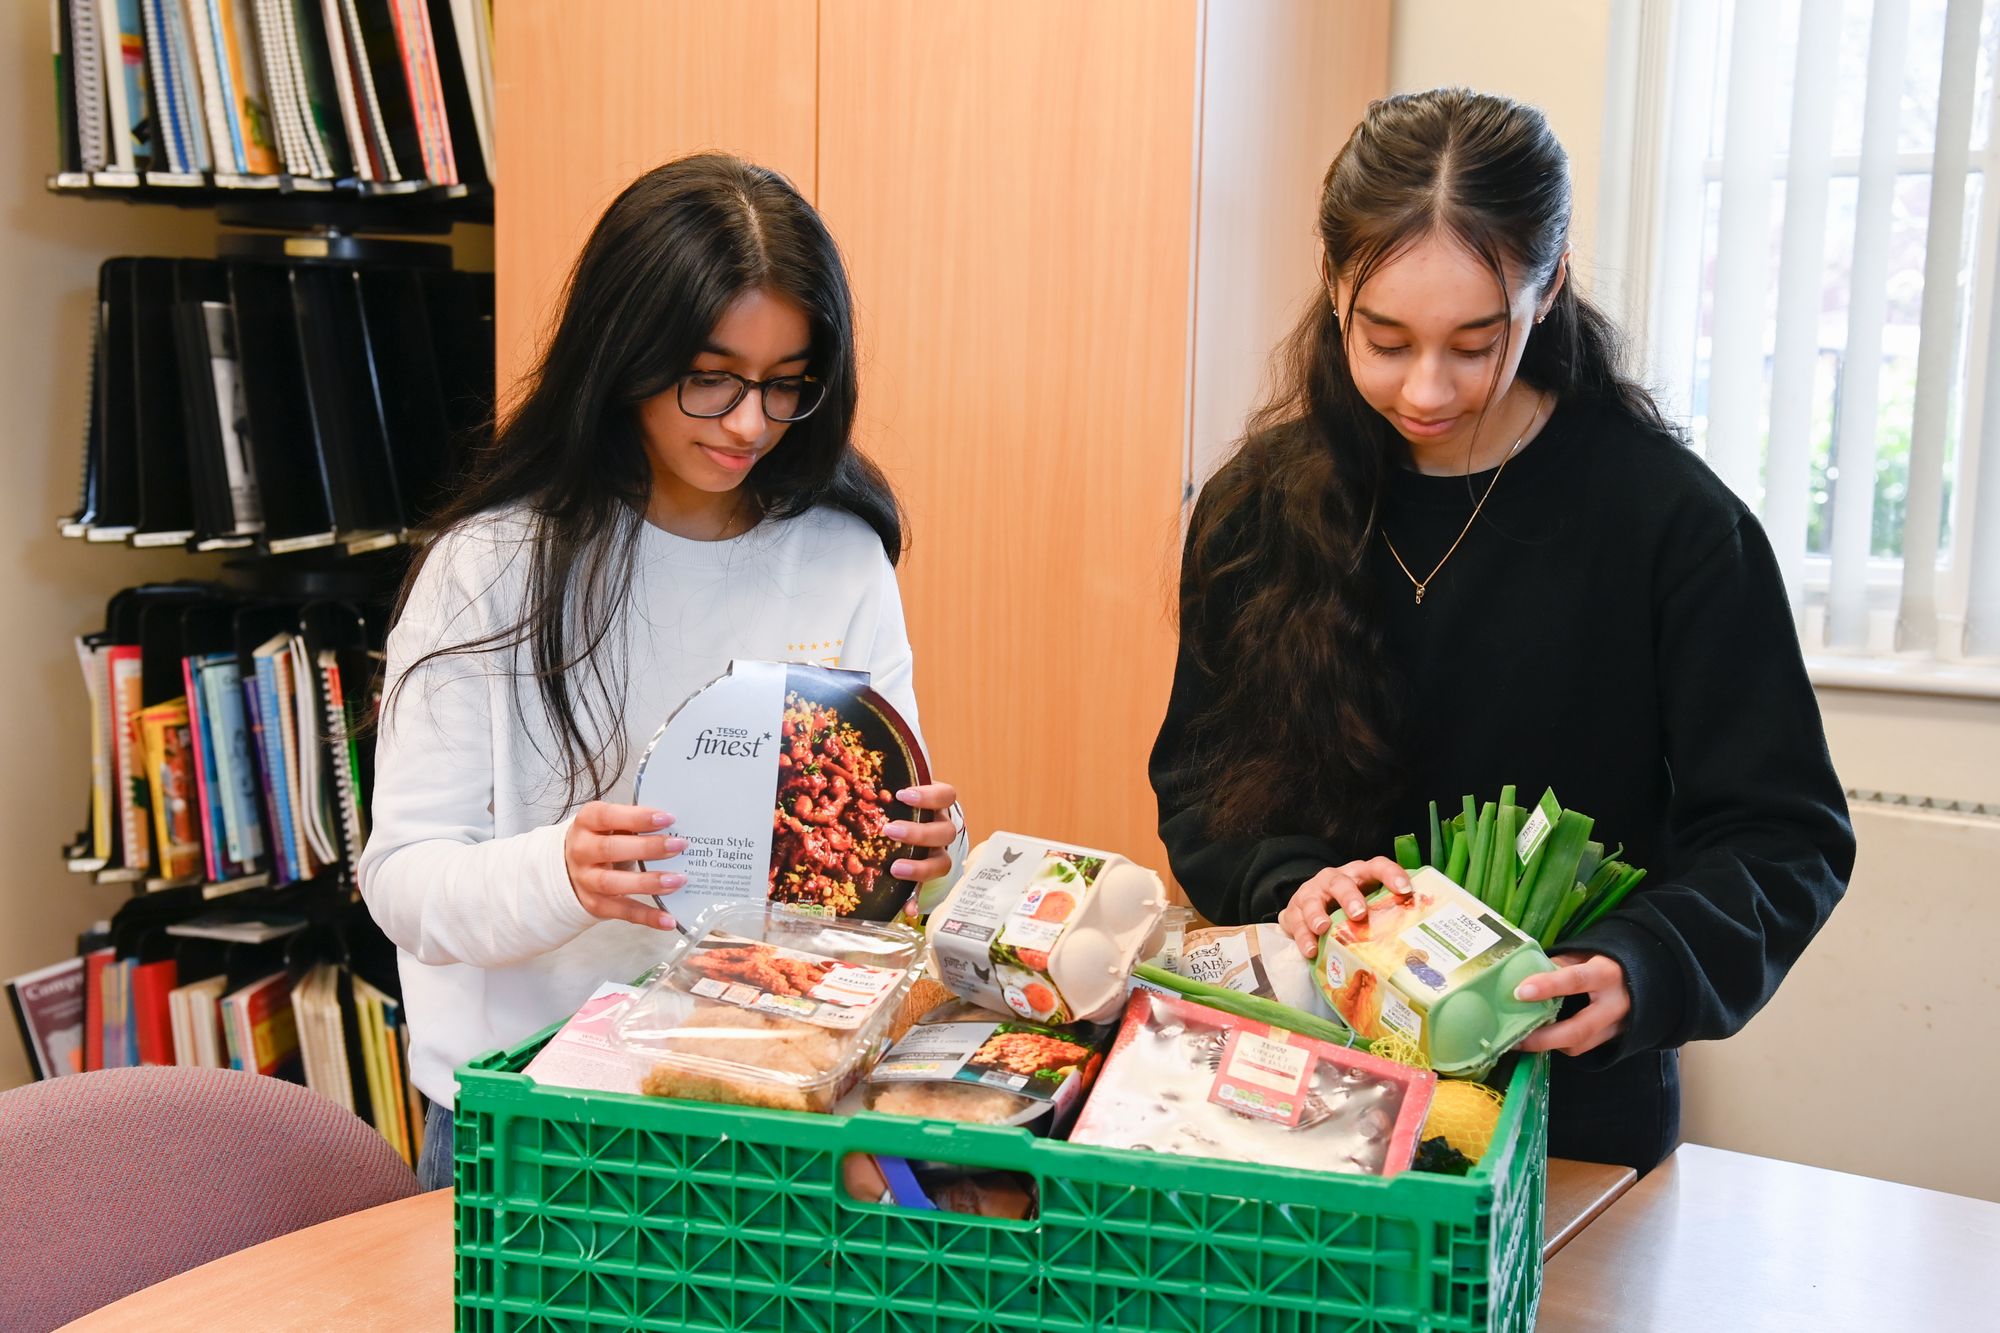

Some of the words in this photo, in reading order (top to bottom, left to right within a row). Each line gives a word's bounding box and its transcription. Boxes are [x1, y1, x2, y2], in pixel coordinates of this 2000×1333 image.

[716, 727, 748, 736] TESCO
[686, 729, 763, 760] finest
[726, 836, 755, 850] Style
[681, 847, 713, 857] Lamb
[716, 848, 754, 861] Tagine
[688, 859, 708, 868] with
[709, 860, 753, 871] Couscous
[1459, 914, 1481, 932] TESCO
[1187, 942, 1221, 960] TESCO
